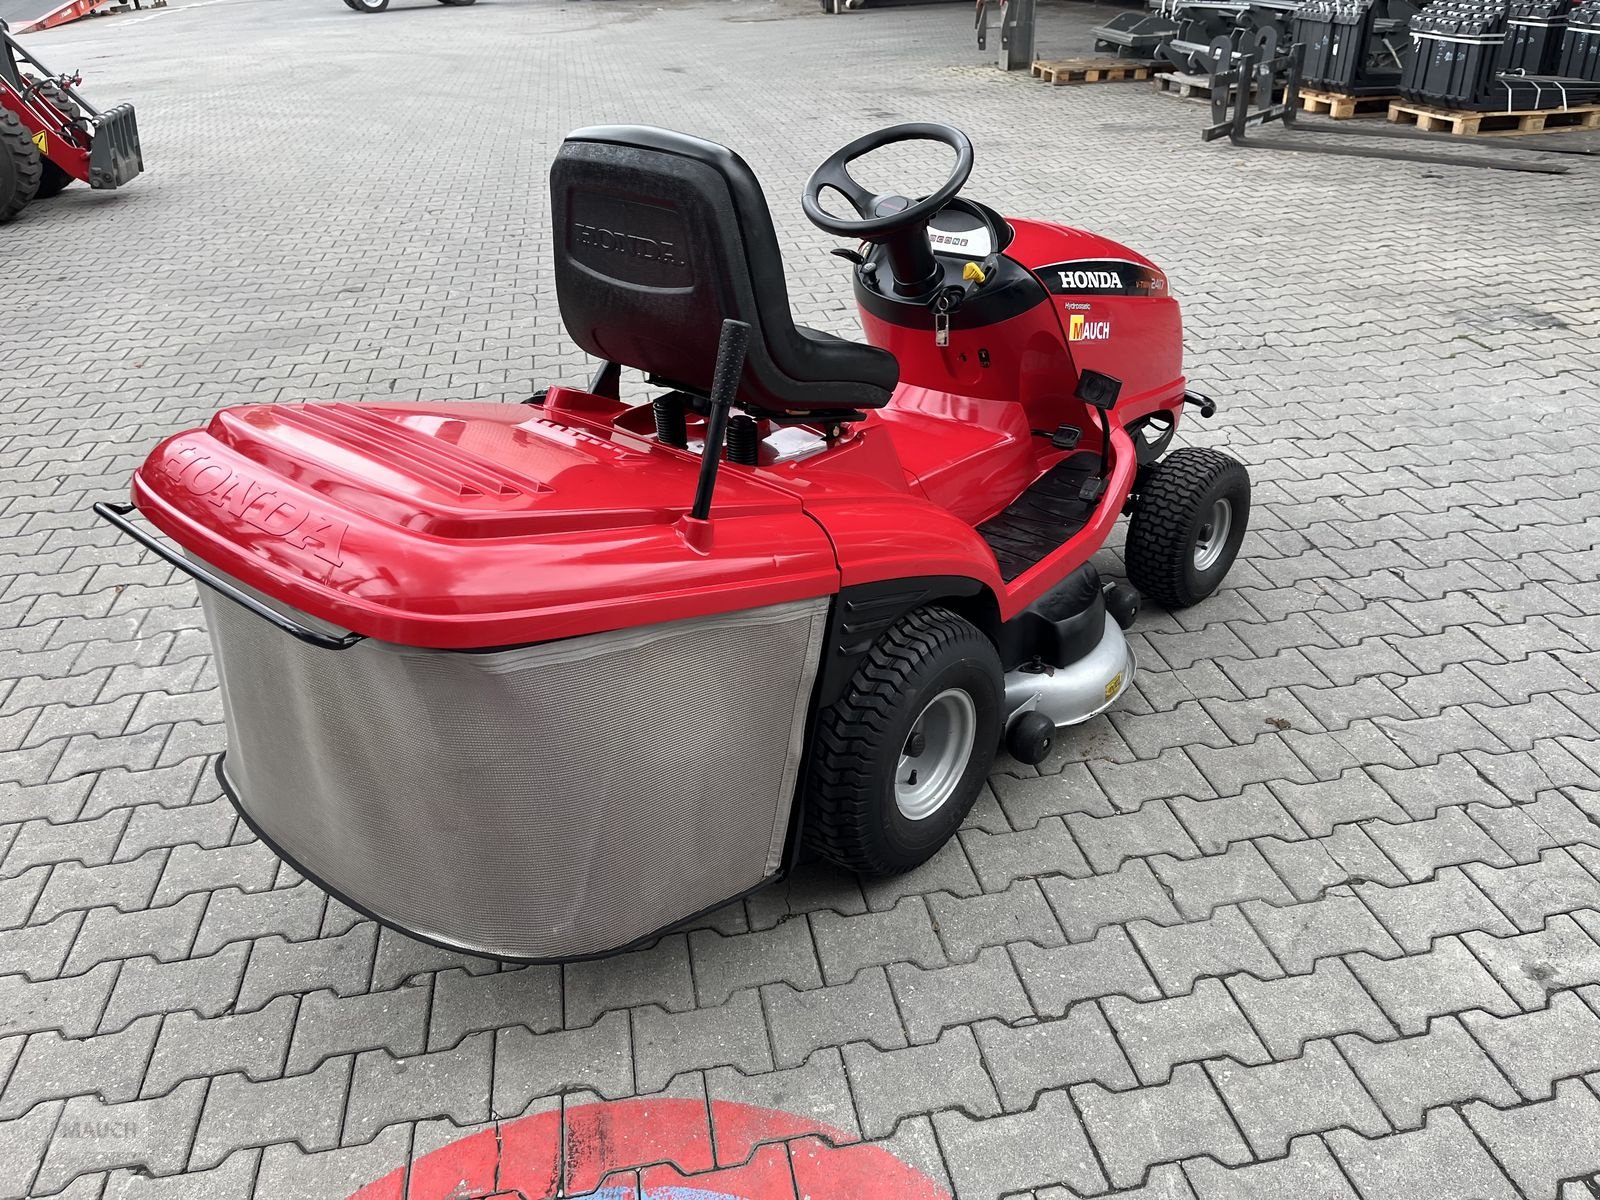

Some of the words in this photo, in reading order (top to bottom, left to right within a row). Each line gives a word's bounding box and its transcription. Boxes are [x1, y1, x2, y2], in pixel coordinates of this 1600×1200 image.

[574, 223, 686, 265] HONDA
[1057, 271, 1123, 289] HONDA
[1073, 321, 1110, 340] MAUCH
[163, 442, 349, 569] HONDA
